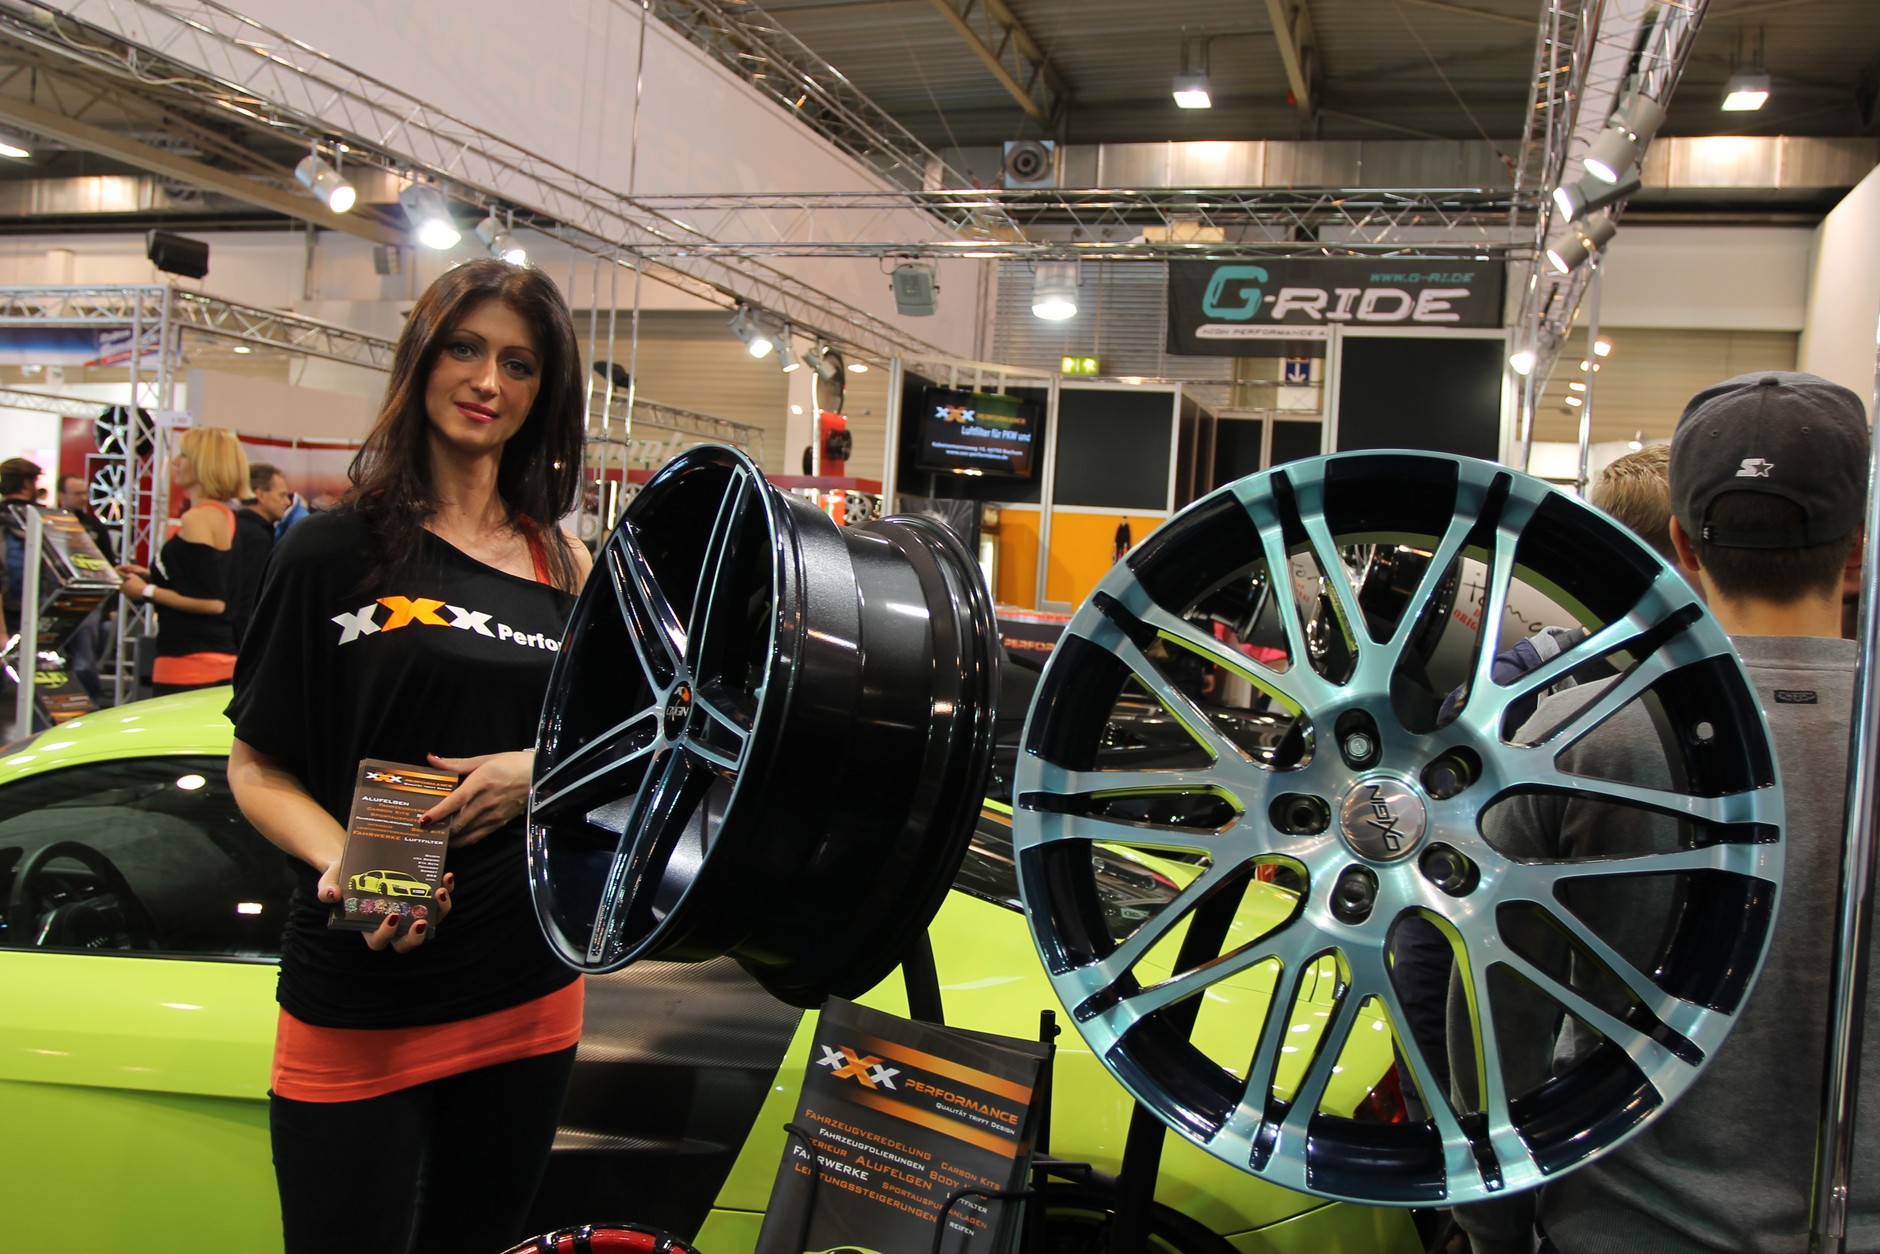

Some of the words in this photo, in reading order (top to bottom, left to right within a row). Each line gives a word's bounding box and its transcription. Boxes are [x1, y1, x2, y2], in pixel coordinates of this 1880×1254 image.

[1202, 265, 1470, 321] G-RIDE
[961, 425, 991, 438] Luftfilter
[991, 428, 1002, 439] für
[1001, 429, 1018, 441] PKW
[361, 795, 410, 806] ALUFELGEN
[351, 830, 402, 841] FAHRWERKE
[404, 836, 444, 845] LUFTFILTER
[904, 1078, 1019, 1126] PERFORMANCE
[805, 1109, 933, 1161] FAHRZEUGVEREDELUNG
[990, 1121, 1016, 1135] DESIGN
[793, 1145, 869, 1181] FARWERKE
[808, 1137, 849, 1158] ERIEUR
[819, 1127, 925, 1171] FAHRZEUGFOLIERUNGEN
[855, 1155, 933, 1191] ALUFELGEN
[929, 1170, 960, 1188] BODY
[940, 1161, 978, 1181] CARBON
[979, 1176, 1001, 1190] KITS
[794, 1162, 938, 1223] LEITUNGSSTEIGERUNGEN
[881, 1181, 988, 1229] SPORTAUSPUANLAGEN
[949, 1221, 975, 1236] REIFEN
